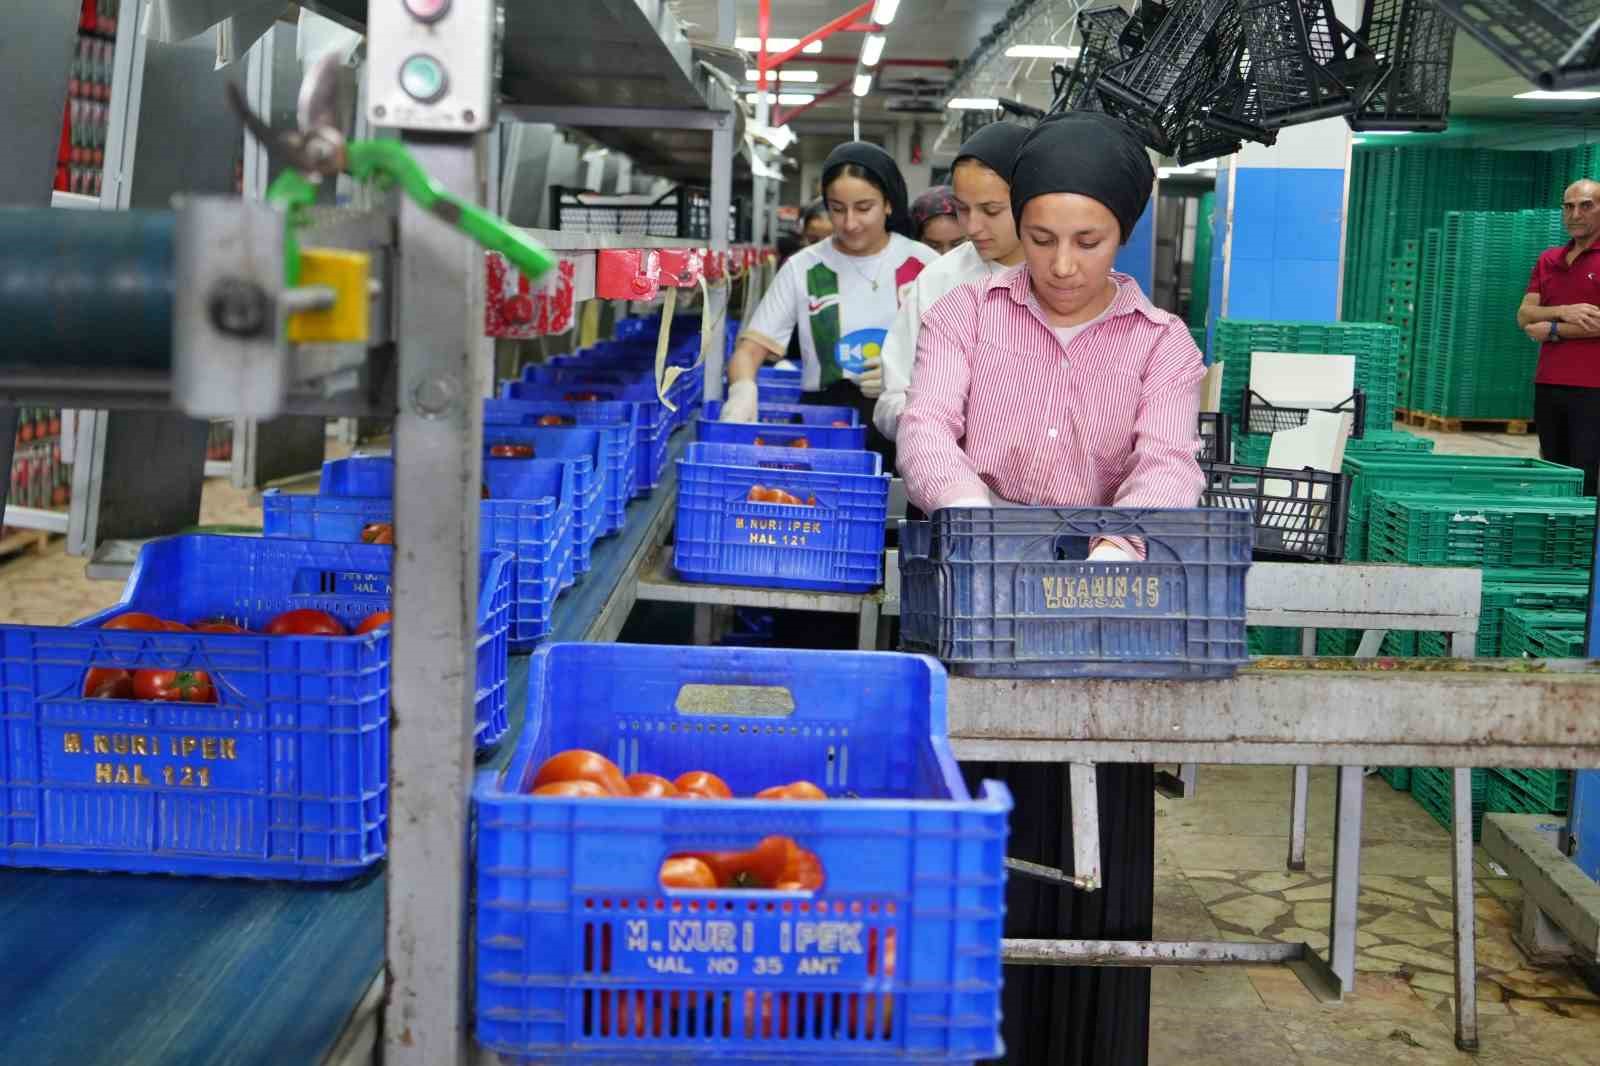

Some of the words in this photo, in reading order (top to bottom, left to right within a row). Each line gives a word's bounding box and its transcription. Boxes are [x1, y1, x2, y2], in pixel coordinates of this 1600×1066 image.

[749, 533, 776, 545] HAL
[783, 535, 807, 546] 121
[1132, 576, 1159, 608] 15
[96, 763, 150, 785] HAL
[163, 765, 210, 787] 121
[707, 956, 739, 975] NO
[752, 956, 784, 975] 35
[797, 956, 843, 975] ANT
